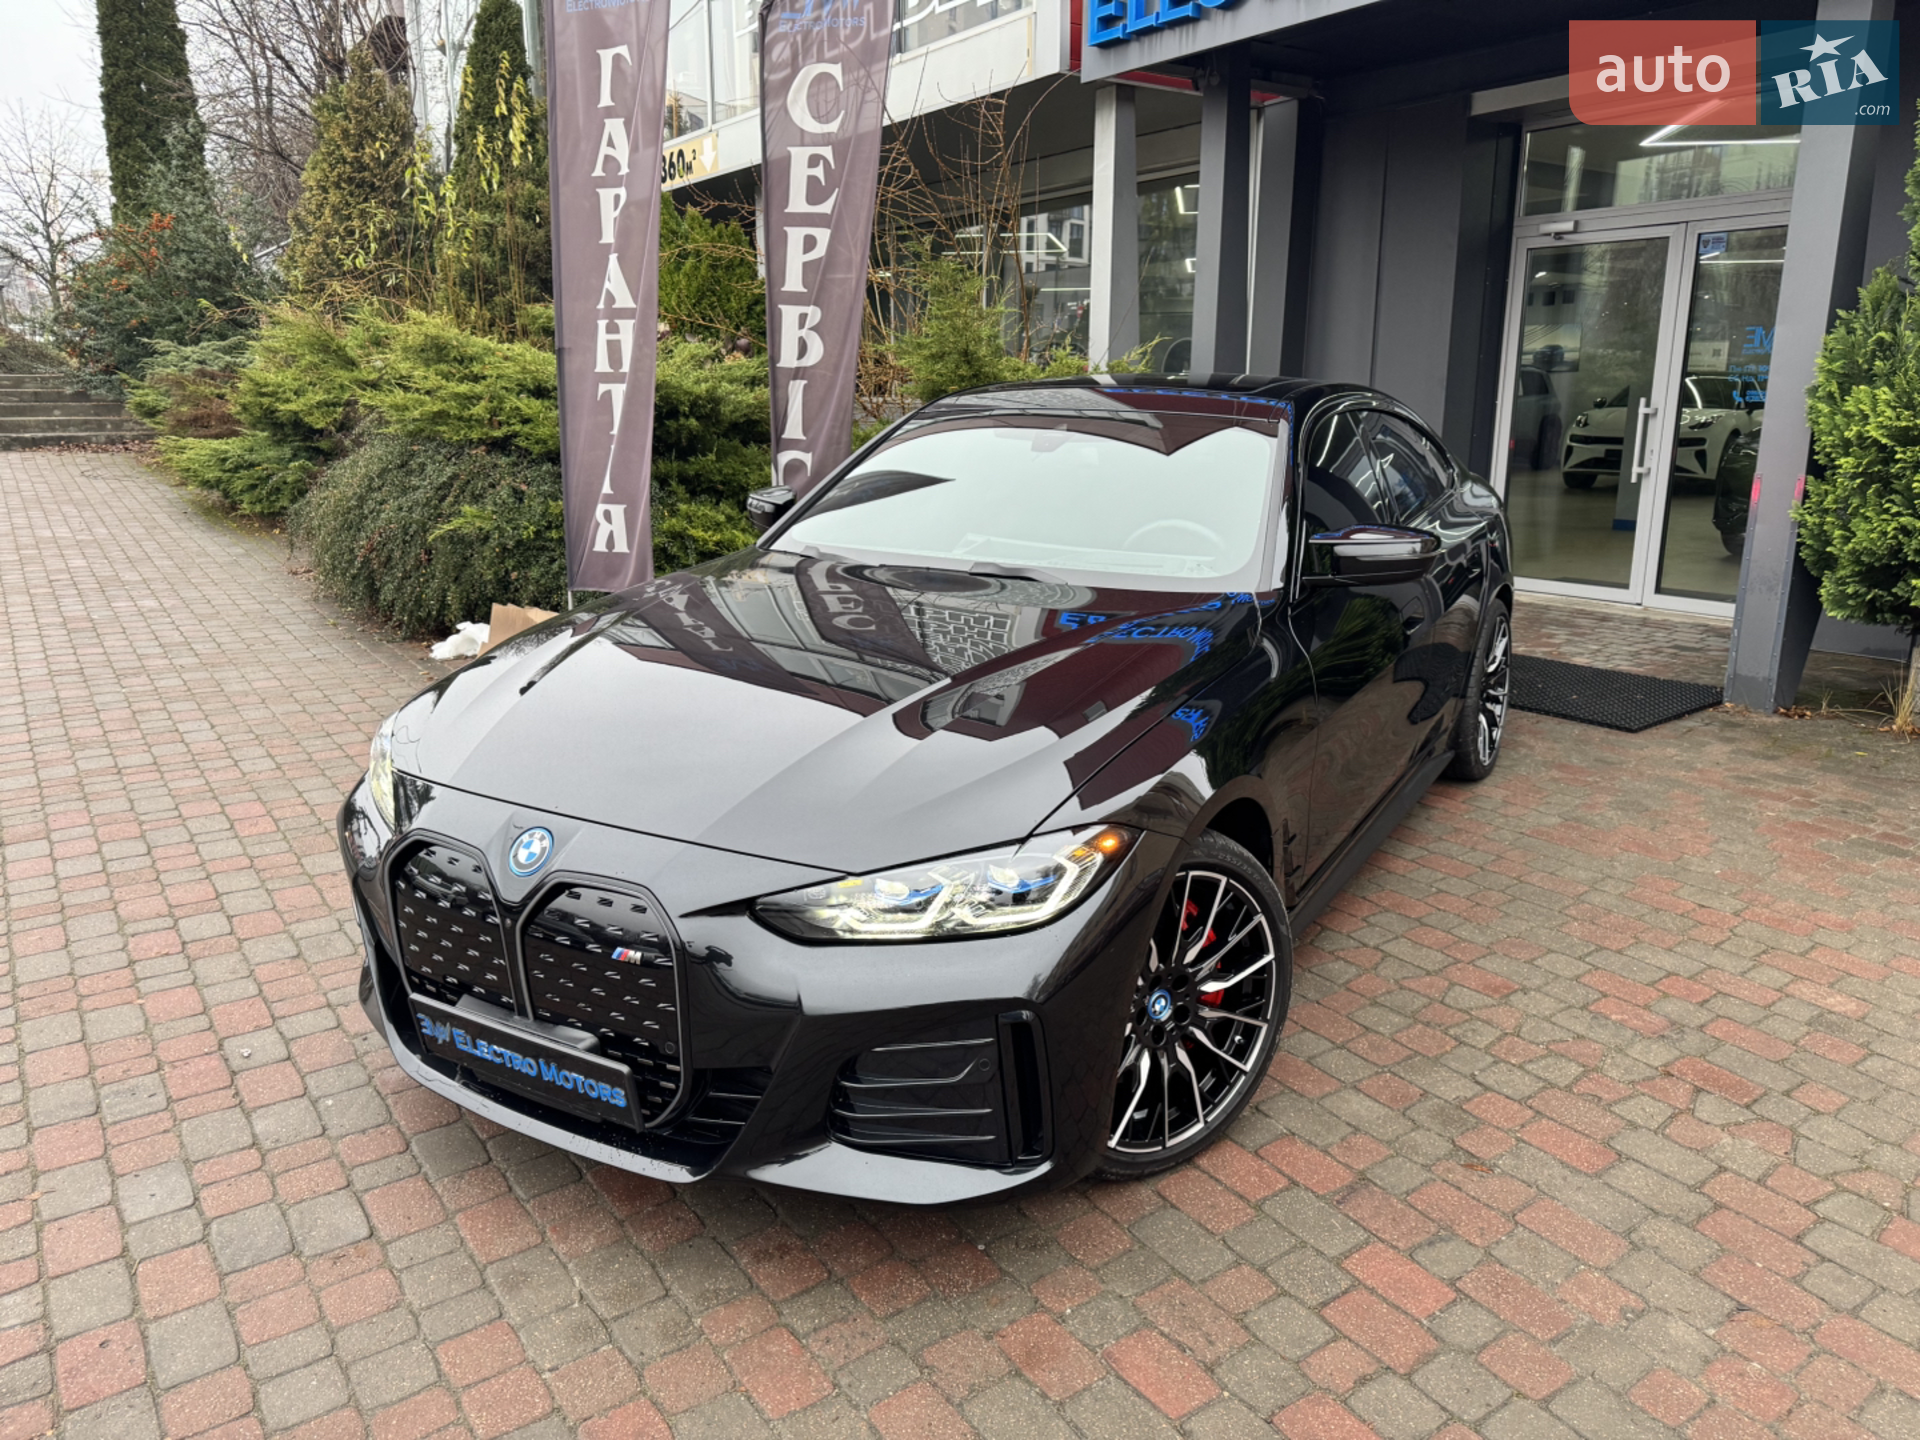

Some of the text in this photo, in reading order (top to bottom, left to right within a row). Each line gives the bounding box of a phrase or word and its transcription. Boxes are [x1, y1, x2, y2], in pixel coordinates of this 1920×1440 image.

[590, 44, 637, 553] ГАРАНТІЯ
[452, 1028, 539, 1078] ELECTRO
[538, 1057, 628, 1109] MOTORS
